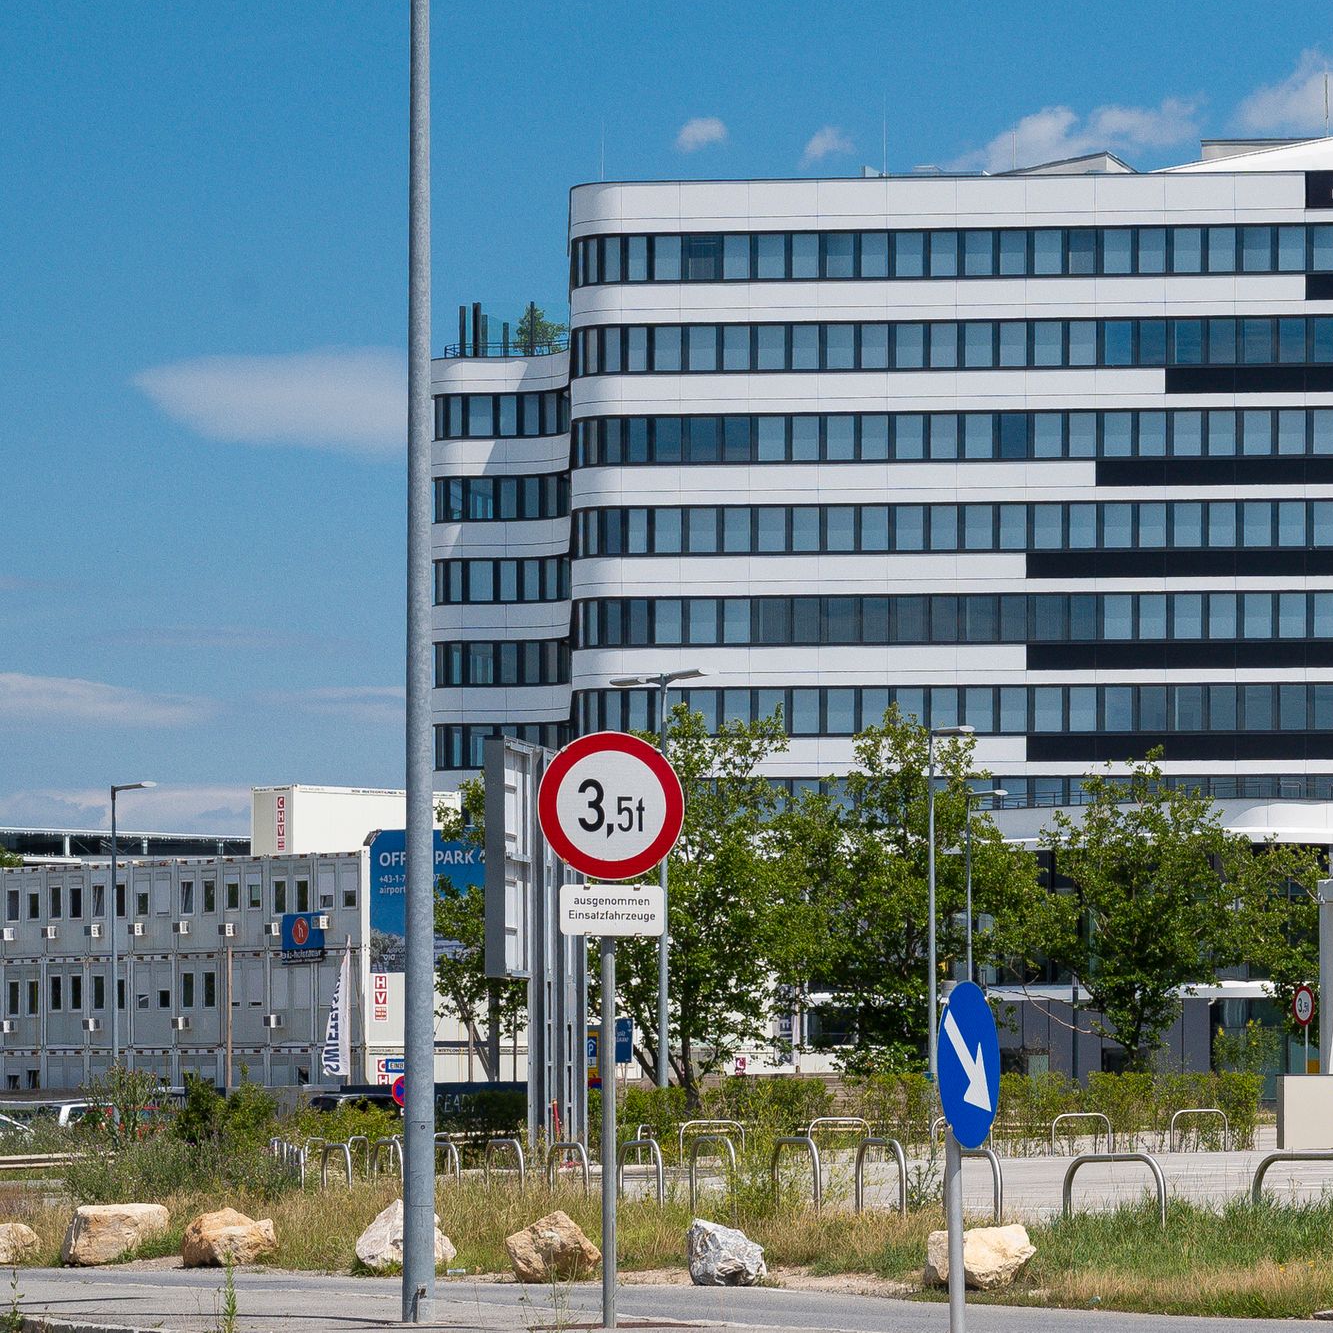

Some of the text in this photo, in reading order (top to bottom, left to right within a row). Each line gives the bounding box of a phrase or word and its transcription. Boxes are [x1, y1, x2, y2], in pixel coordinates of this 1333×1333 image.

[435, 850, 475, 865] PARK
[573, 896, 650, 907] ausgenommen
[568, 909, 656, 923] Einsatzfahrzeuge
